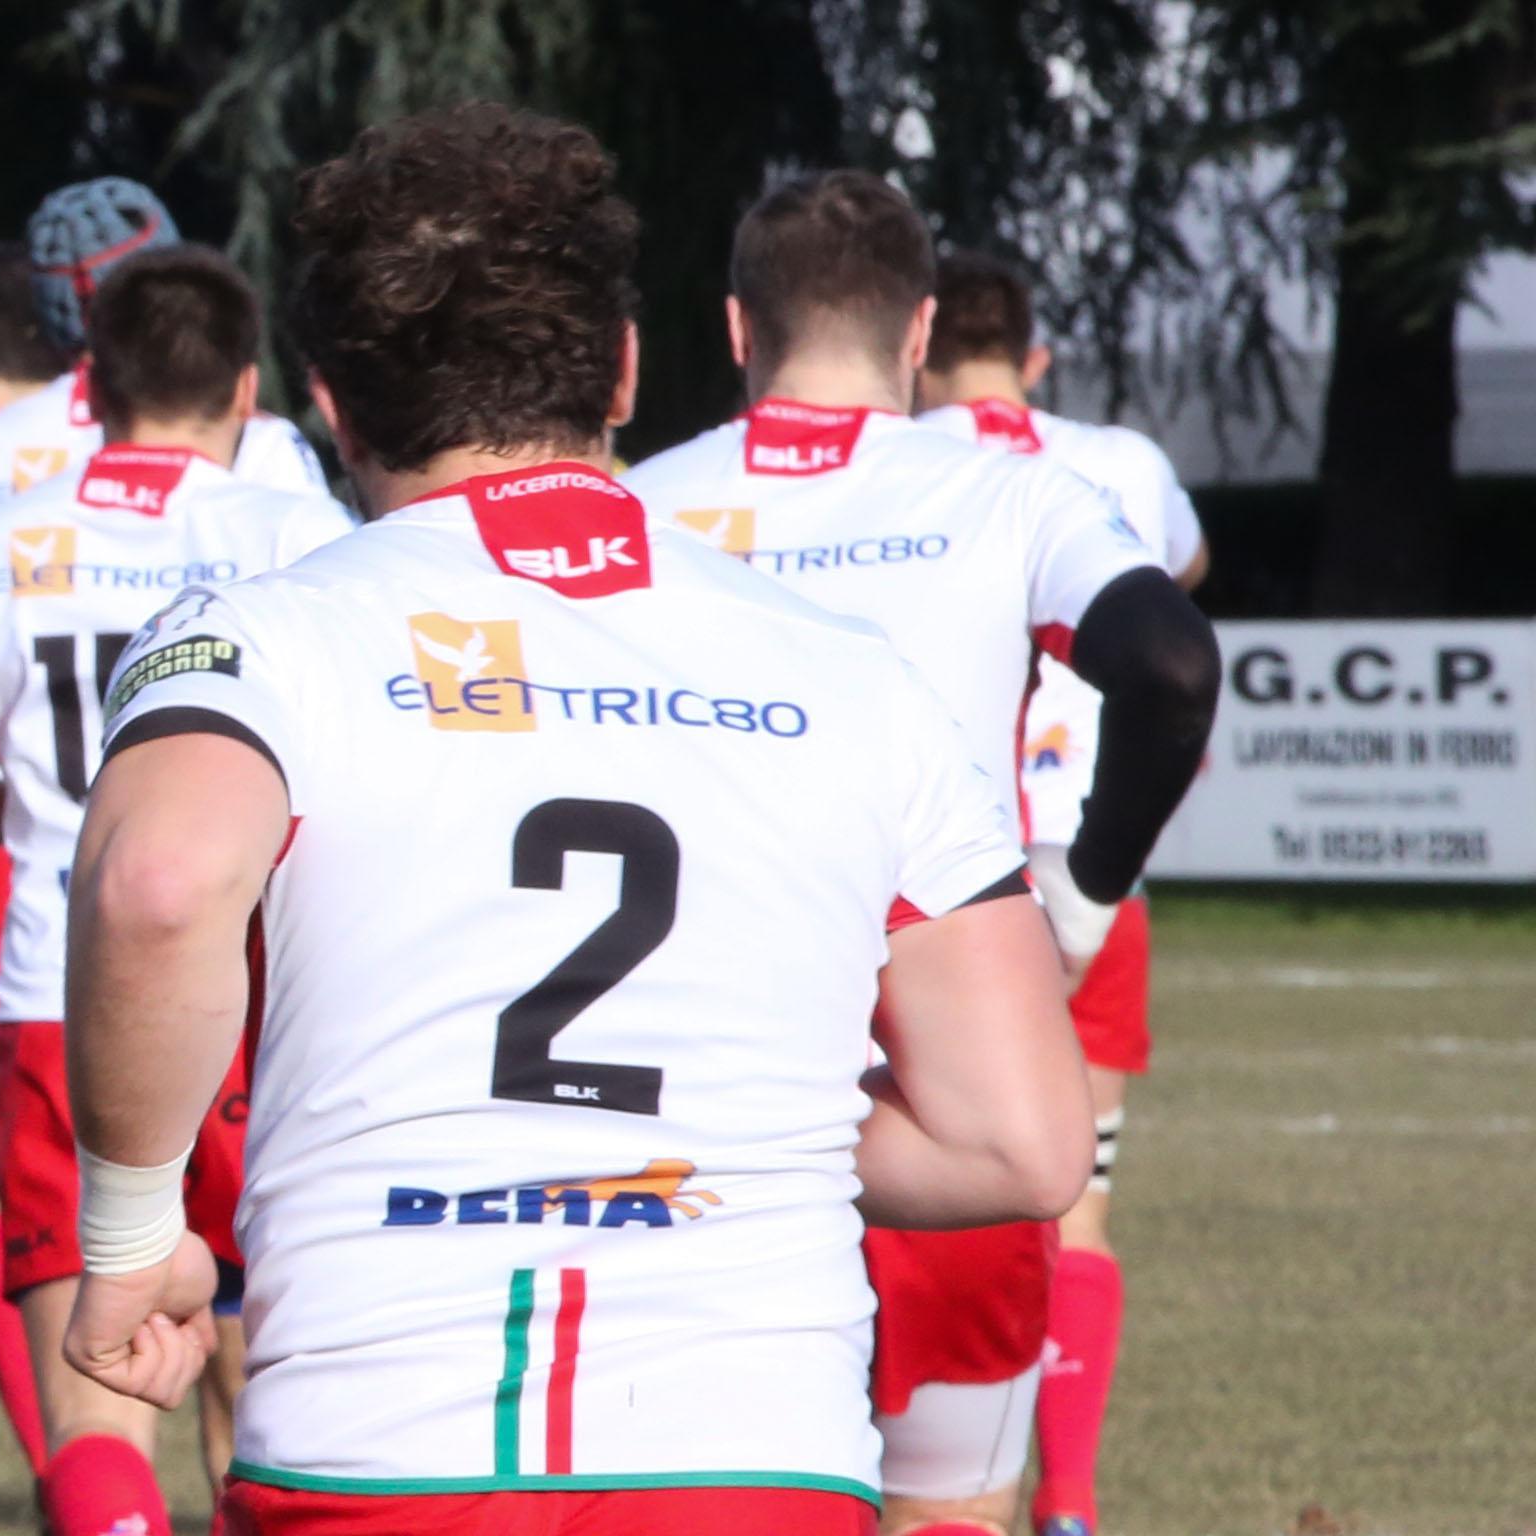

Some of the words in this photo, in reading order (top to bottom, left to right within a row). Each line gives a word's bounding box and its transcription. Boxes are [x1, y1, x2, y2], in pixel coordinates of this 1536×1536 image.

[753, 446, 841, 468] BLK
[502, 537, 639, 579] BLK
[731, 533, 950, 575] TTRIC80
[1231, 645, 1510, 706] G.C.P.
[385, 673, 809, 738] ELETTRIC80
[491, 797, 680, 1116] 2
[553, 1083, 601, 1101] BLK
[381, 1186, 674, 1228] BEMA
